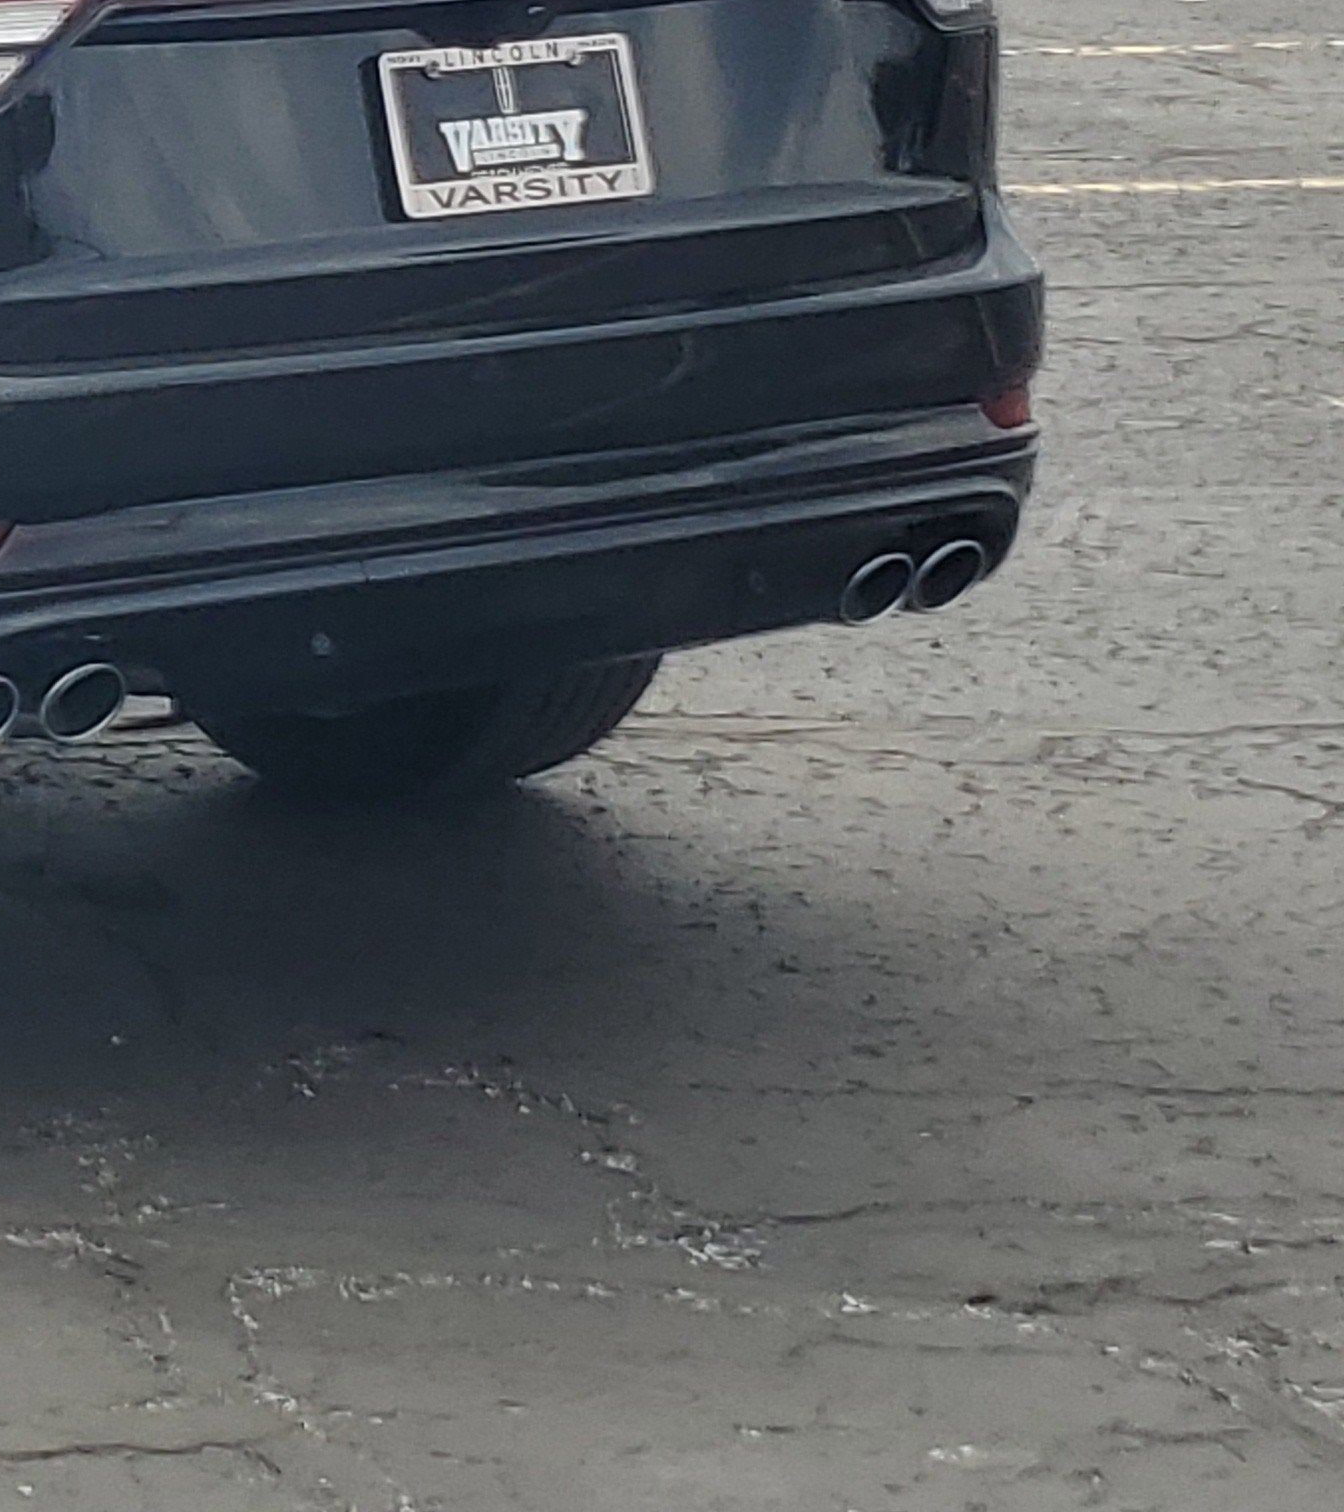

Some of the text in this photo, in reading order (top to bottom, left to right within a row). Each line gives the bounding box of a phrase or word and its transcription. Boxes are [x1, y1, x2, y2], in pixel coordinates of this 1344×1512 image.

[443, 42, 560, 68] LINCOLN
[438, 108, 588, 173] VARSITY
[430, 170, 622, 209] VARSITY
